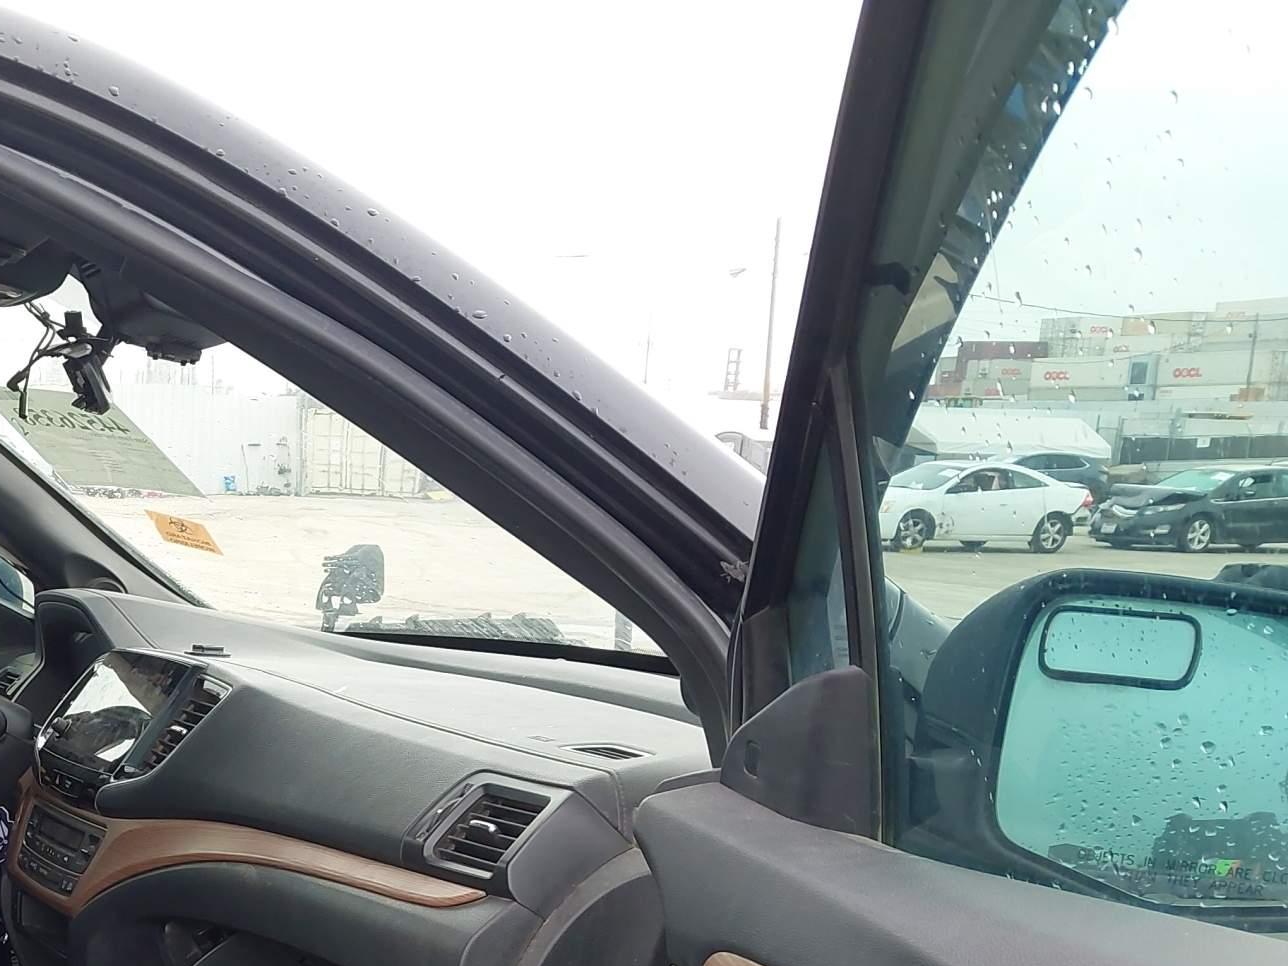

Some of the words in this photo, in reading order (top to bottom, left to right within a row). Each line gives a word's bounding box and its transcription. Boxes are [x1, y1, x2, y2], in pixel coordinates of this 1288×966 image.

[1043, 371, 1070, 381] OOCL
[1173, 367, 1202, 378] OOCL
[1225, 865, 1253, 881] ARE
[1208, 880, 1264, 896] APPEAR
